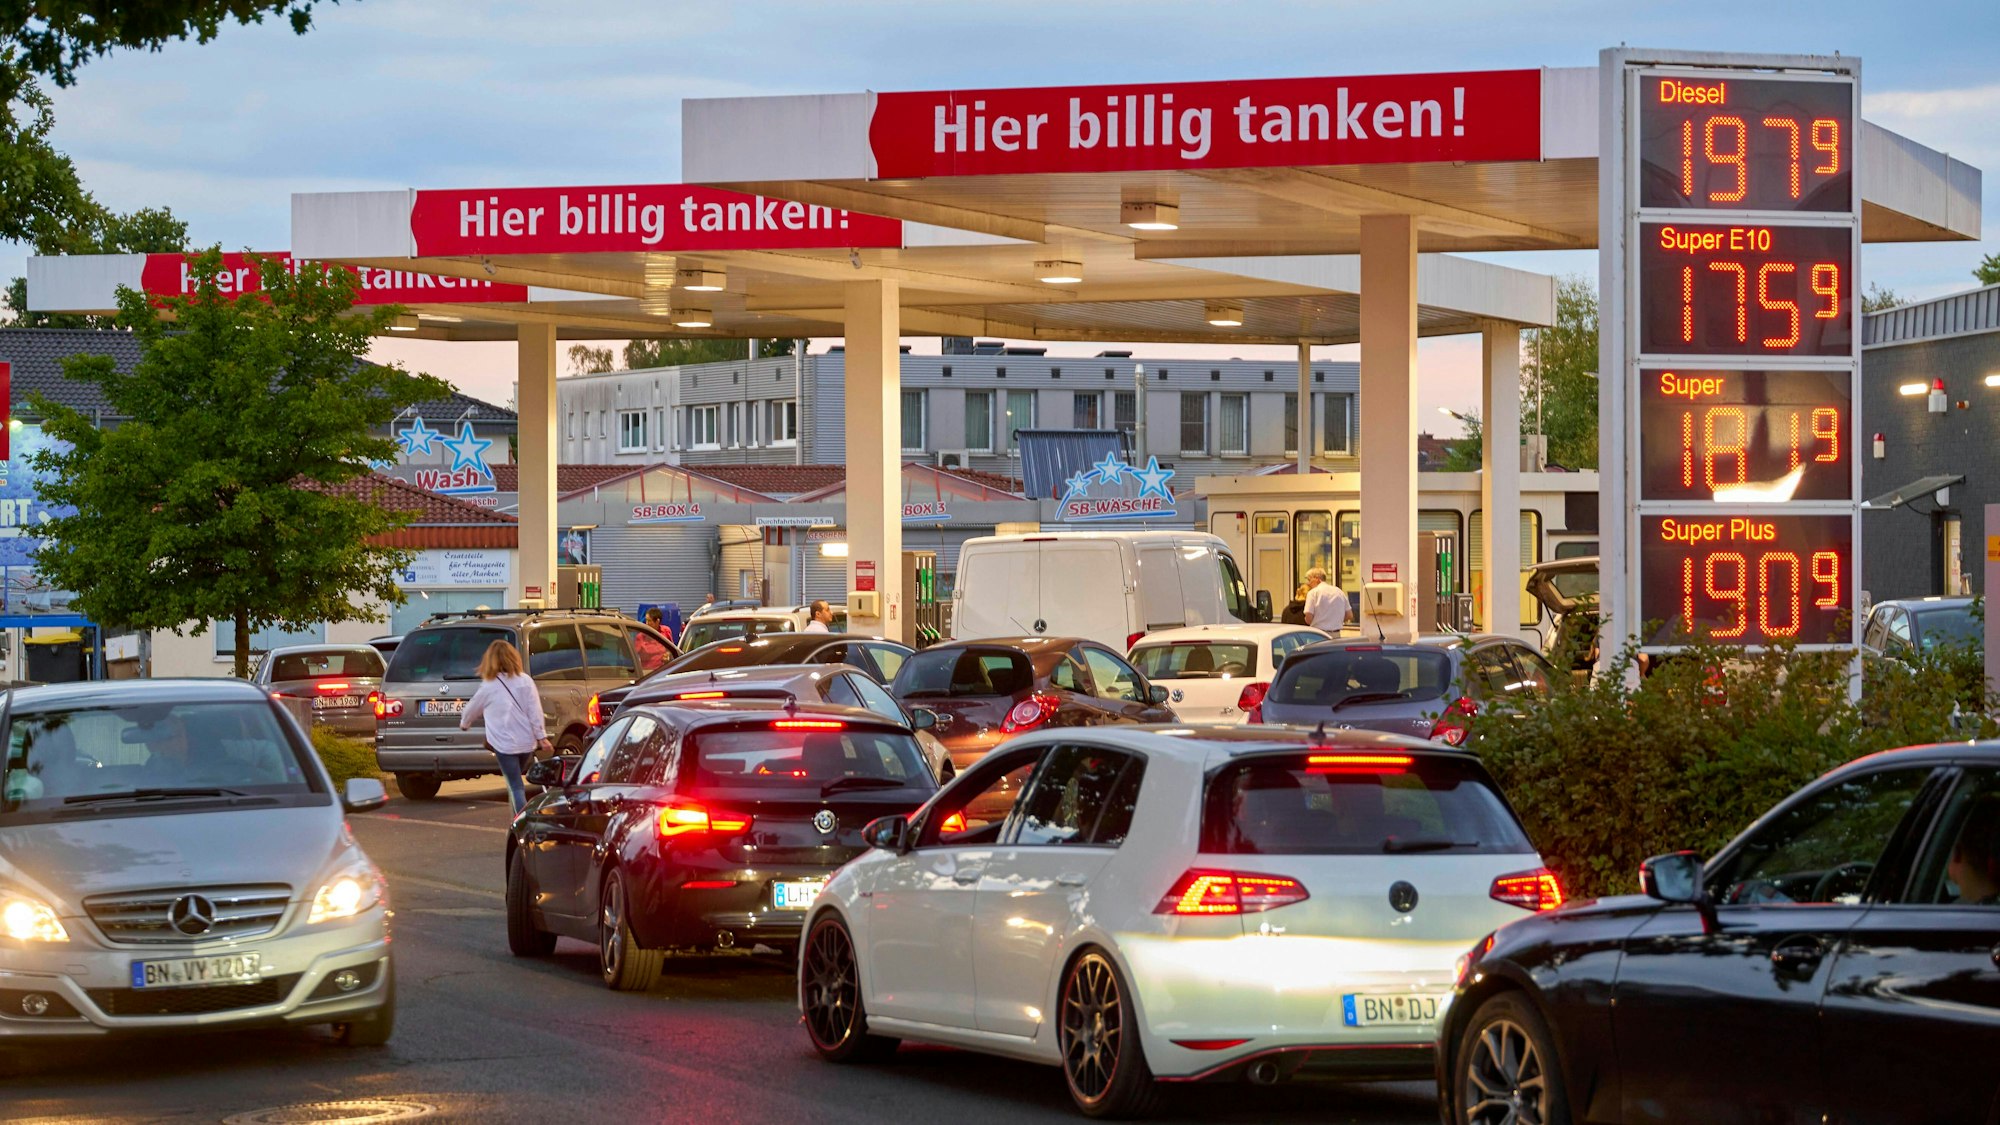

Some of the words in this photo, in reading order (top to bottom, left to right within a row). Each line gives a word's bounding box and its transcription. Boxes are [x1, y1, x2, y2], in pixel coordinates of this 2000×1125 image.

[1660, 79, 1725, 104] Diesel
[934, 101, 1048, 152] Hier
[1069, 94, 1212, 160] billig
[1233, 87, 1465, 142] tanken!
[460, 197, 545, 237] Hier
[559, 193, 665, 245] billig
[1660, 227, 1724, 253] Super
[1729, 228, 1771, 251] E10
[180, 262, 250, 293] Her
[1660, 372, 1724, 400] Super
[416, 467, 480, 490] Wash
[461, 496, 498, 506] wäsche
[633, 504, 686, 518] SB-BOX
[690, 503, 700, 514] 4
[937, 502, 946, 513] 3
[1068, 497, 1162, 516] SB-WÄSCHE
[1660, 518, 1725, 546] Super
[1729, 518, 1777, 542] Plus
[462, 560, 506, 570] Hausgeräte
[314, 697, 324, 708] BN
[340, 696, 359, 706] 1969
[427, 702, 440, 712] BN
[787, 886, 810, 902] LH
[145, 963, 169, 985] BN
[1364, 998, 1394, 1021] BN
[1408, 998, 1437, 1020] DJ
